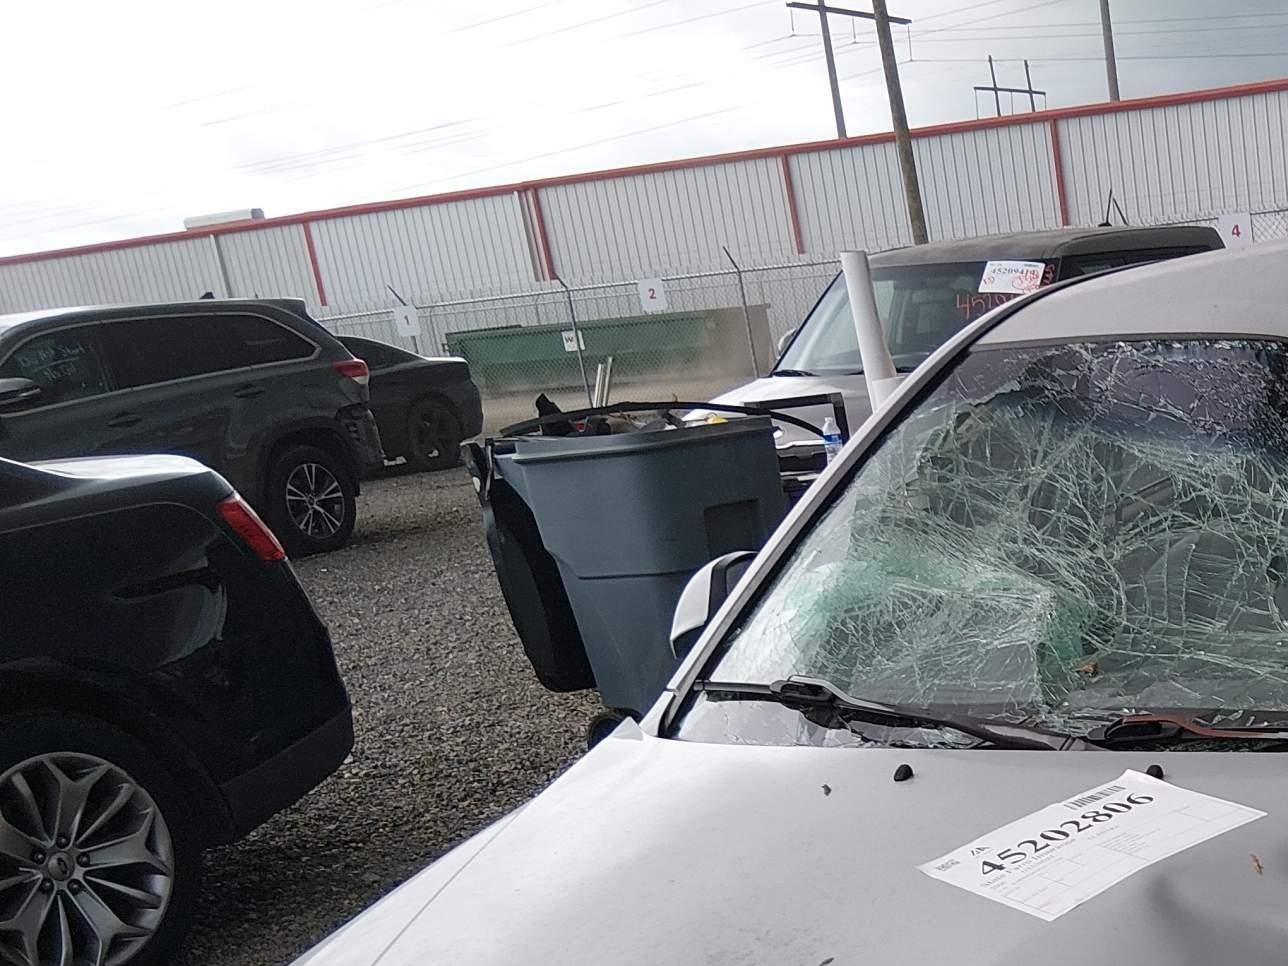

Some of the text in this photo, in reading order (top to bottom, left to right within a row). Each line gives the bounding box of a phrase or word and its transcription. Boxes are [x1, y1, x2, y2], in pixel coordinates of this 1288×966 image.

[1231, 224, 1241, 238] 4
[648, 288, 657, 299] 2
[403, 315, 410, 325] 1
[981, 792, 1154, 875] 45202806
